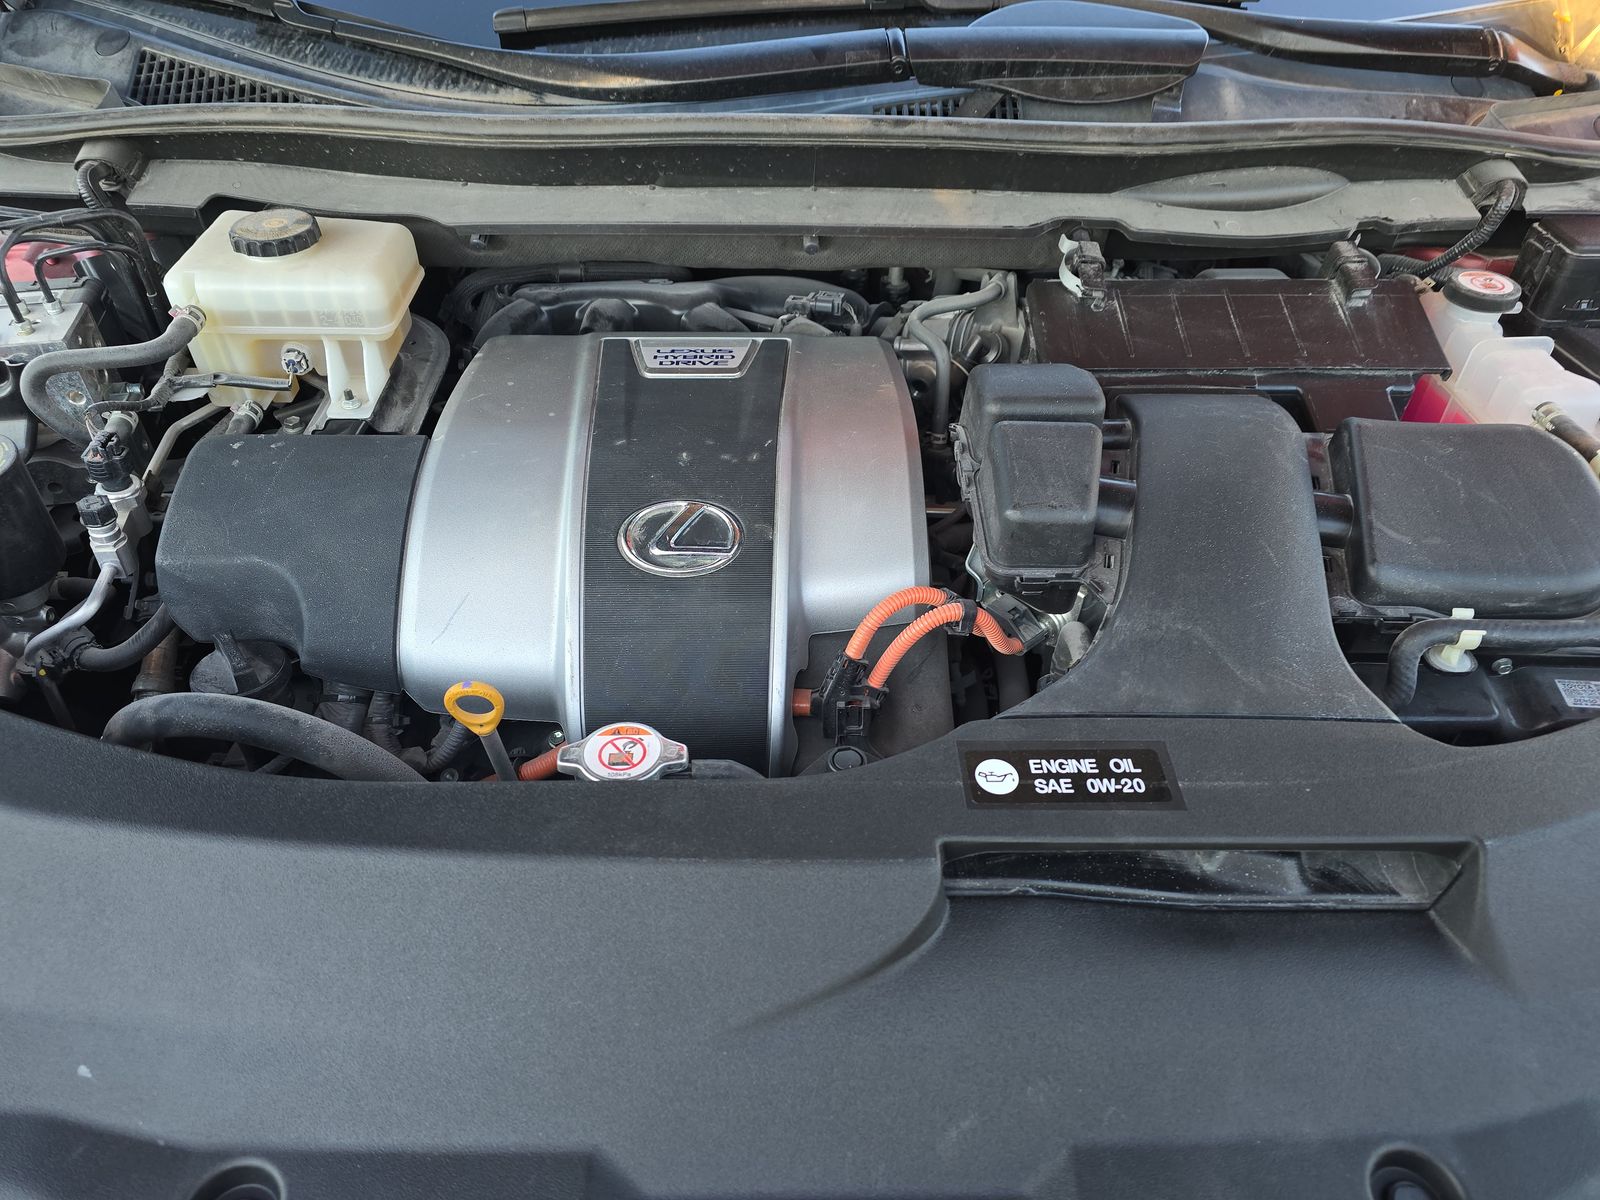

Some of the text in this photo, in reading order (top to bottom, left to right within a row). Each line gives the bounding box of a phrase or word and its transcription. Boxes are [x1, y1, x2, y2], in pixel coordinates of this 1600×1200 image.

[1028, 758, 1142, 774] ENGINE OIL
[1034, 778, 1146, 794] SAE 0W-20
